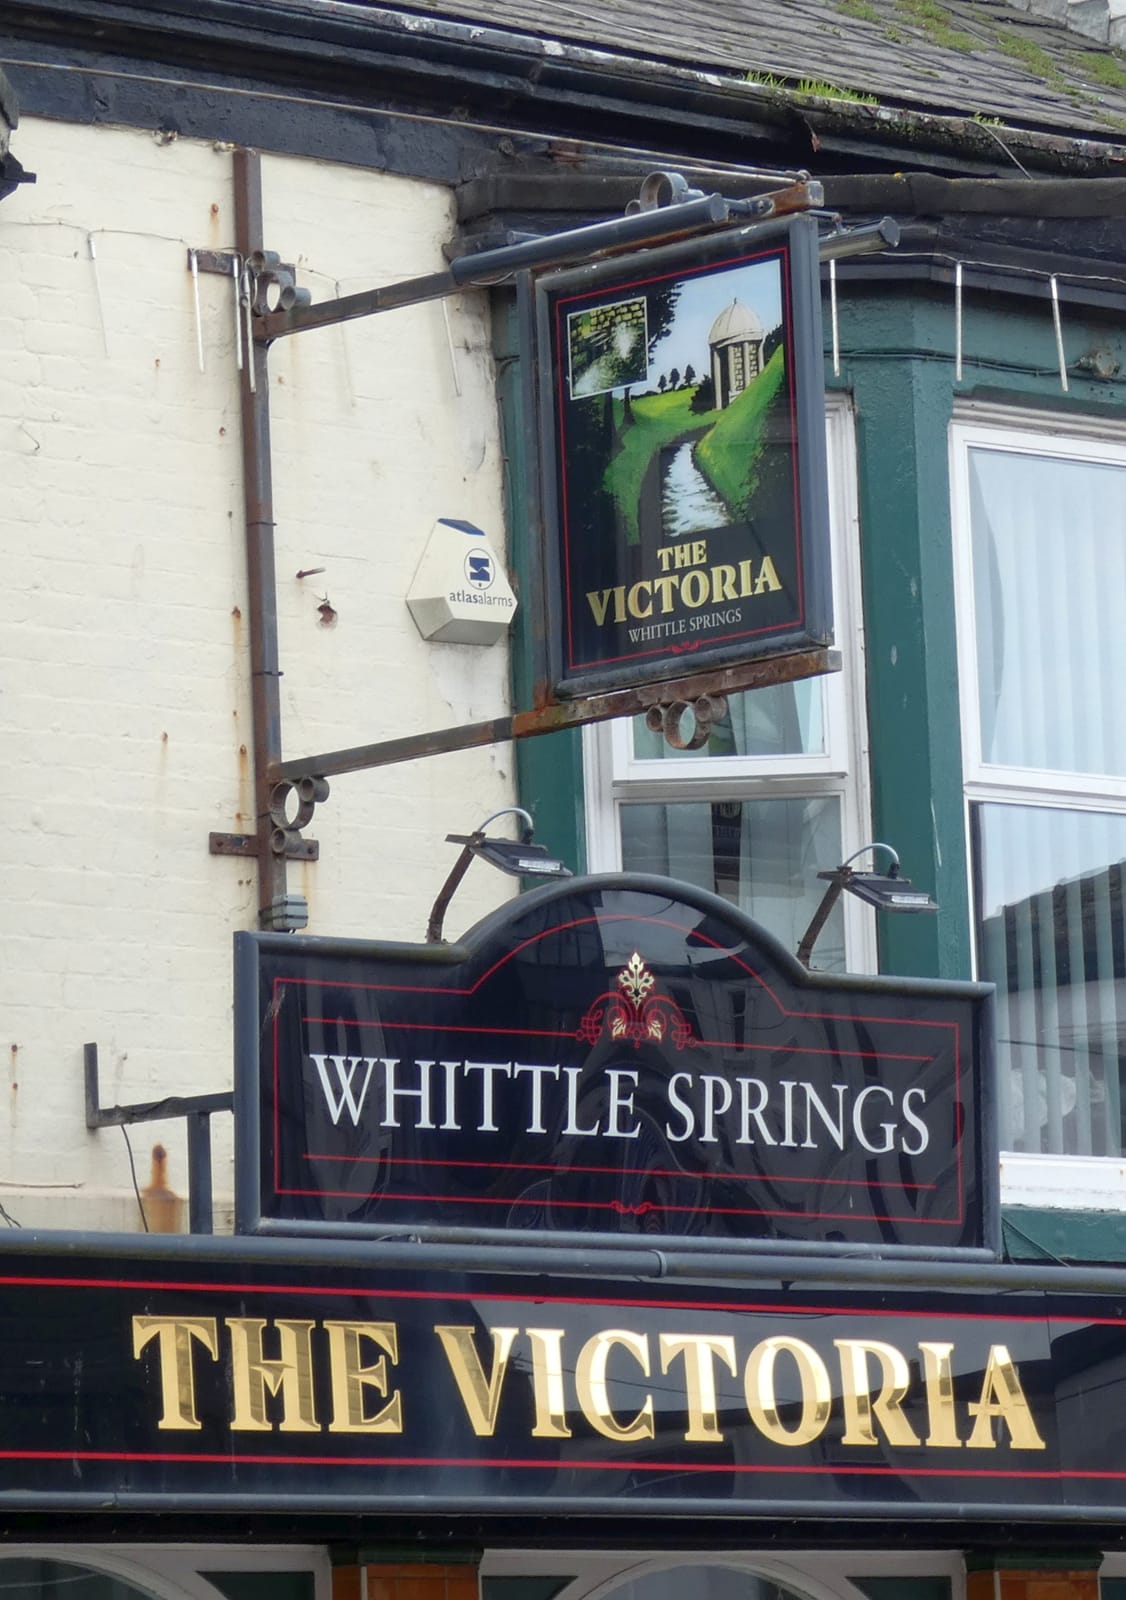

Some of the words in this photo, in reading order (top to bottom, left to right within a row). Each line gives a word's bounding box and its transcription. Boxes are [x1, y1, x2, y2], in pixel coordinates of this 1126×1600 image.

[657, 540, 707, 571] THE
[449, 590, 513, 607] atlasalarms
[586, 556, 782, 627] VICTORIA
[628, 618, 687, 643] WHITTLE
[689, 608, 742, 632] SPRINGS
[309, 1053, 641, 1139] WHITTLE
[666, 1072, 930, 1156] SPRINGS
[131, 1315, 403, 1434] THE
[433, 1325, 1046, 1450] VICTORIA
